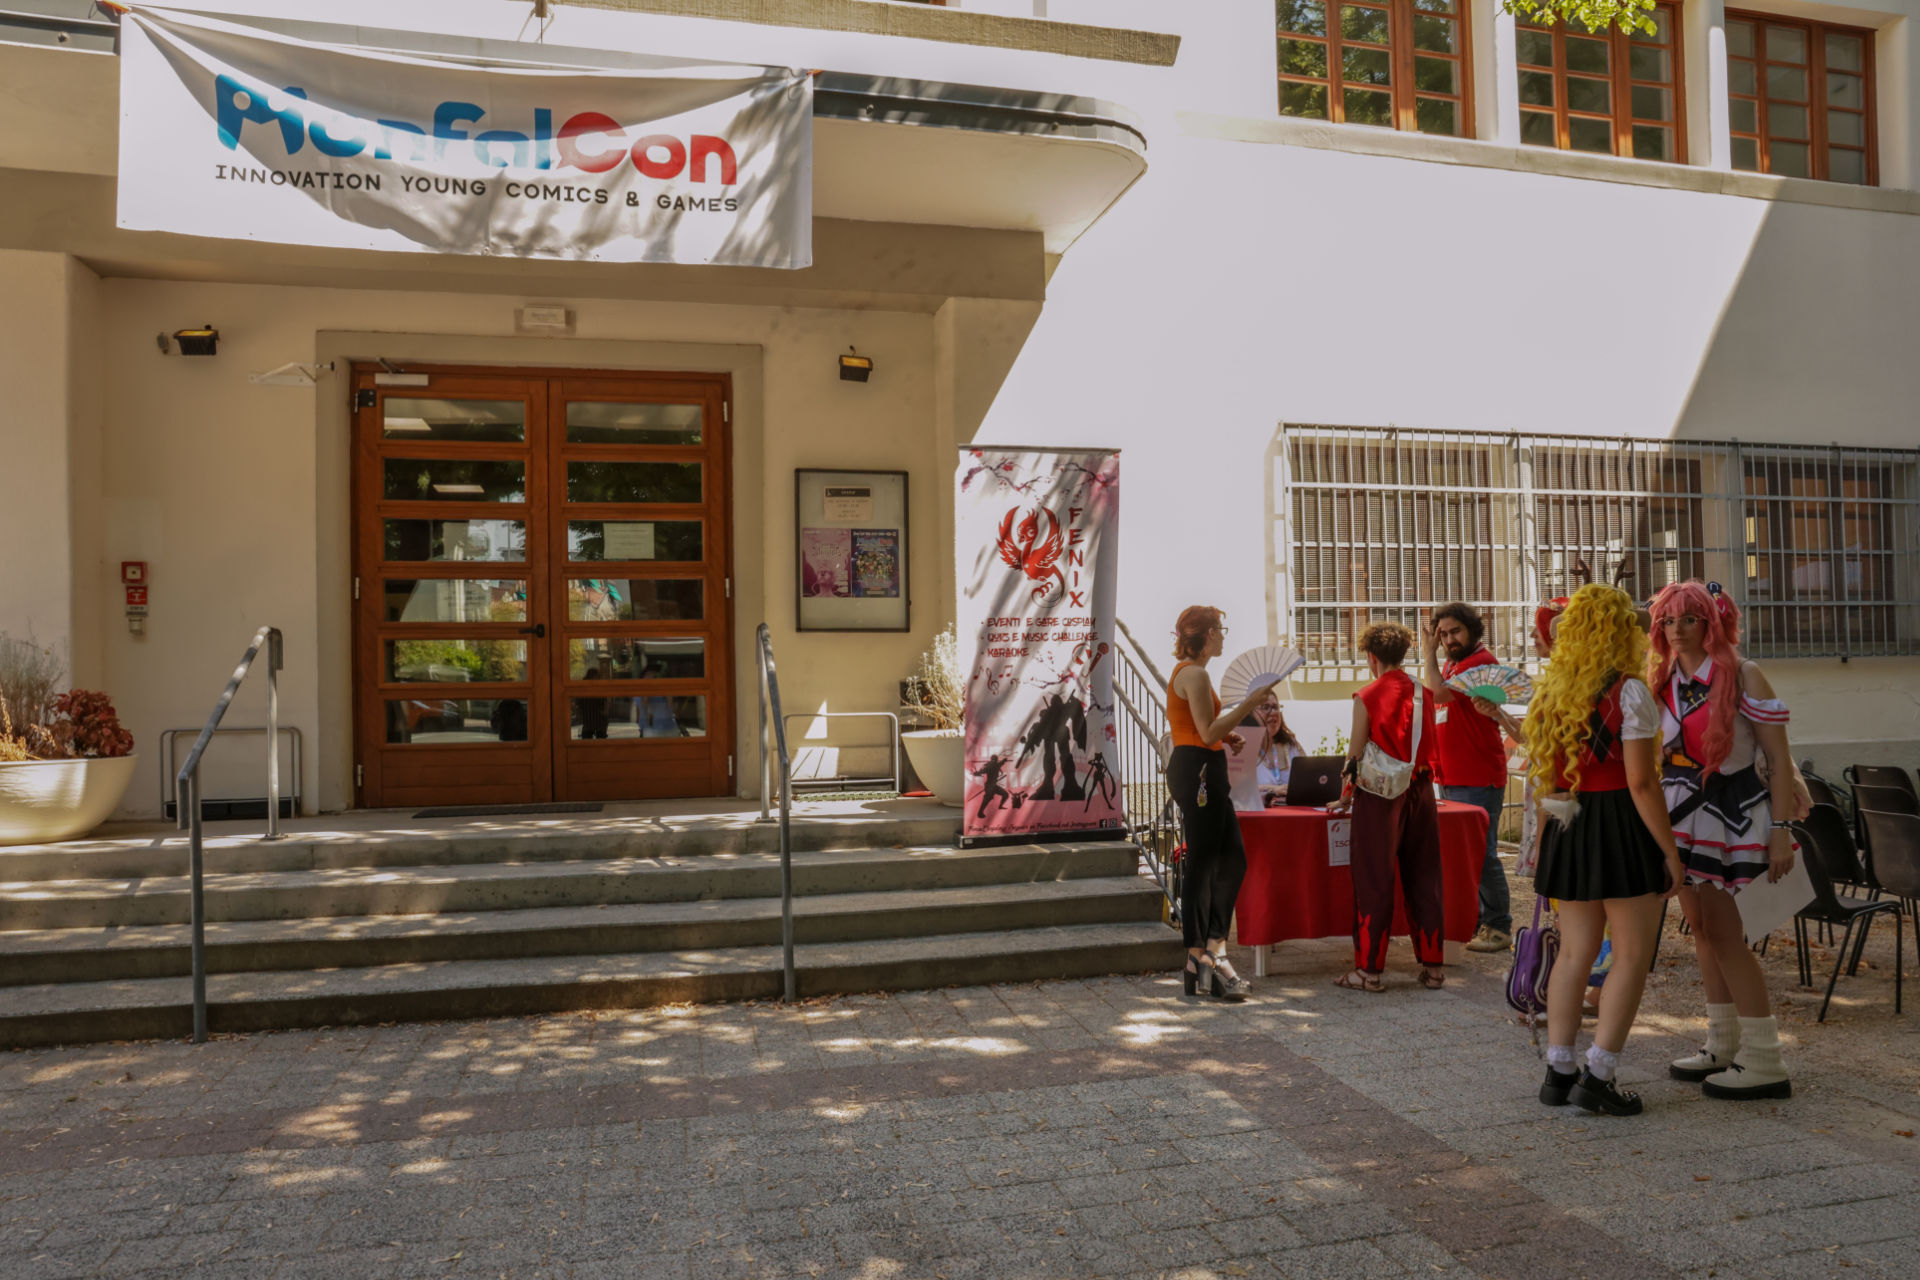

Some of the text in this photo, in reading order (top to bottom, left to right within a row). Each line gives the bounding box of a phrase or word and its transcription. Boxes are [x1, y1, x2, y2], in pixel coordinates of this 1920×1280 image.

[215, 74, 738, 186] MonfalCon
[215, 164, 739, 213] INNOVATION YOUNG COMICS & GAMES
[1068, 507, 1084, 609] FENIX
[987, 617, 1096, 629] EVENTI E GARE COSPLAY
[1012, 632, 1020, 642] E
[1022, 632, 1048, 642] MUSIC
[1051, 631, 1099, 642] CHALLENGE
[987, 647, 1028, 657] KARAOKE
